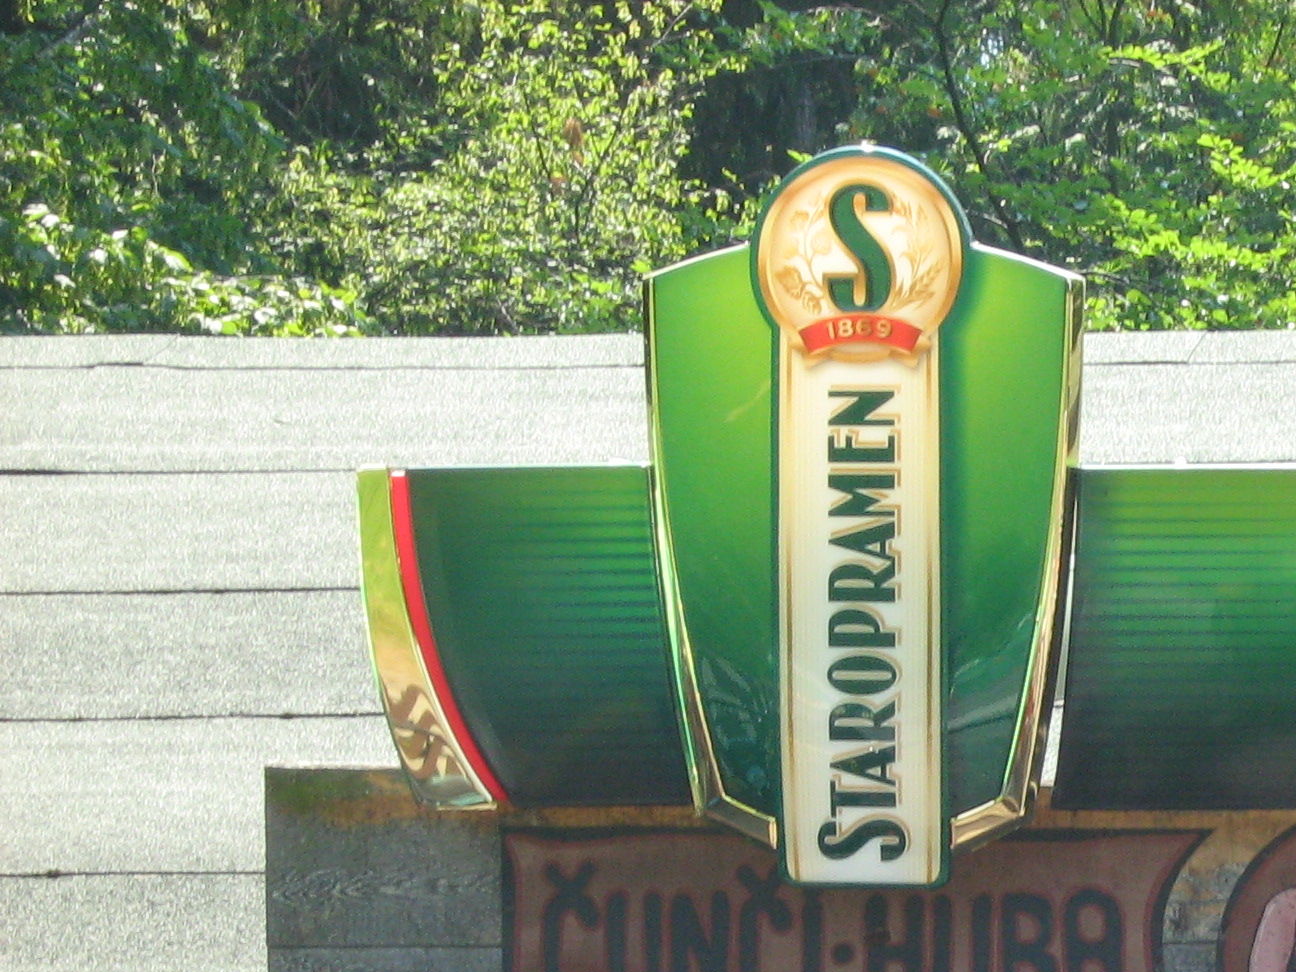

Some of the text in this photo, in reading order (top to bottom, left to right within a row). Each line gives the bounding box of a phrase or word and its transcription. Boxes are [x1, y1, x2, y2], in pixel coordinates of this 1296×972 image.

[825, 182, 893, 312] S
[826, 318, 892, 340] 1869
[817, 387, 906, 864] STAROPRAMEN
